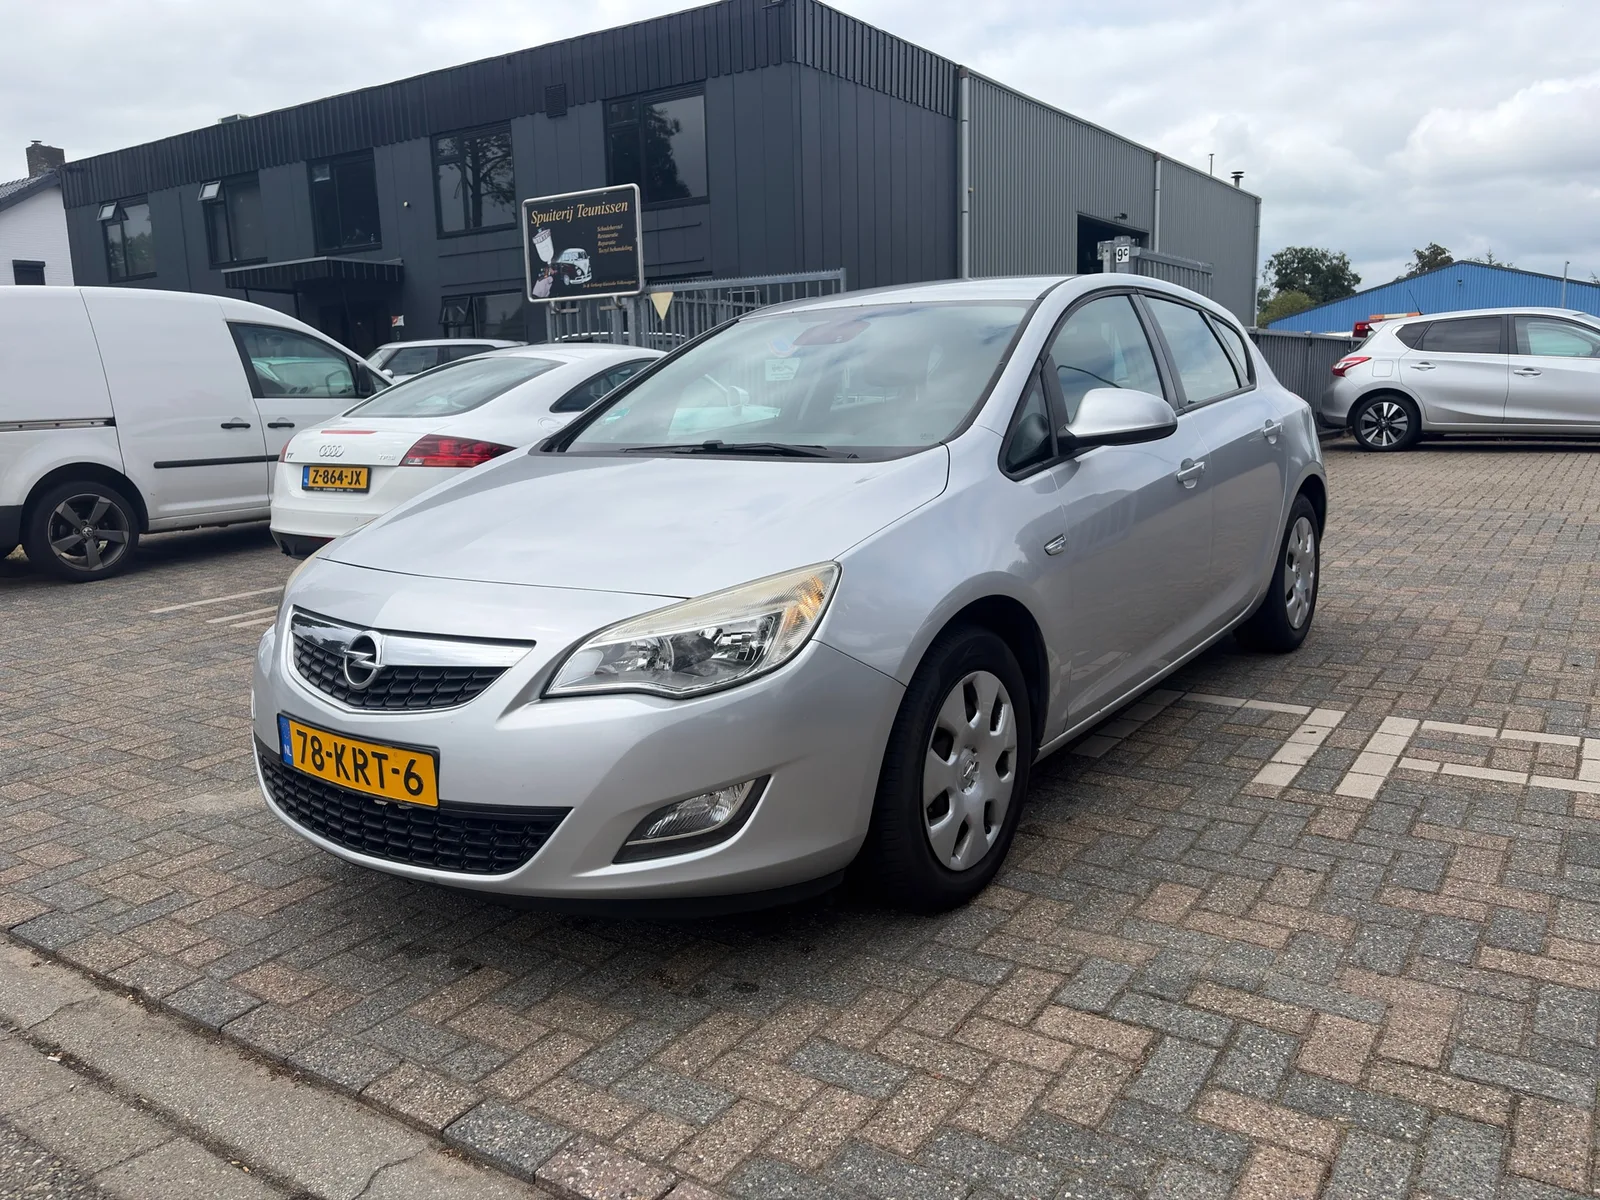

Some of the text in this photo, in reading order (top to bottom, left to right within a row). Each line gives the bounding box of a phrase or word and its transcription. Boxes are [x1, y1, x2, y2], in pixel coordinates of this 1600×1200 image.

[531, 201, 628, 227] Spuiterij Teunissen
[312, 470, 362, 486] Z-864-JX
[284, 744, 292, 756] NL
[296, 730, 424, 796] 78-KRT-6
